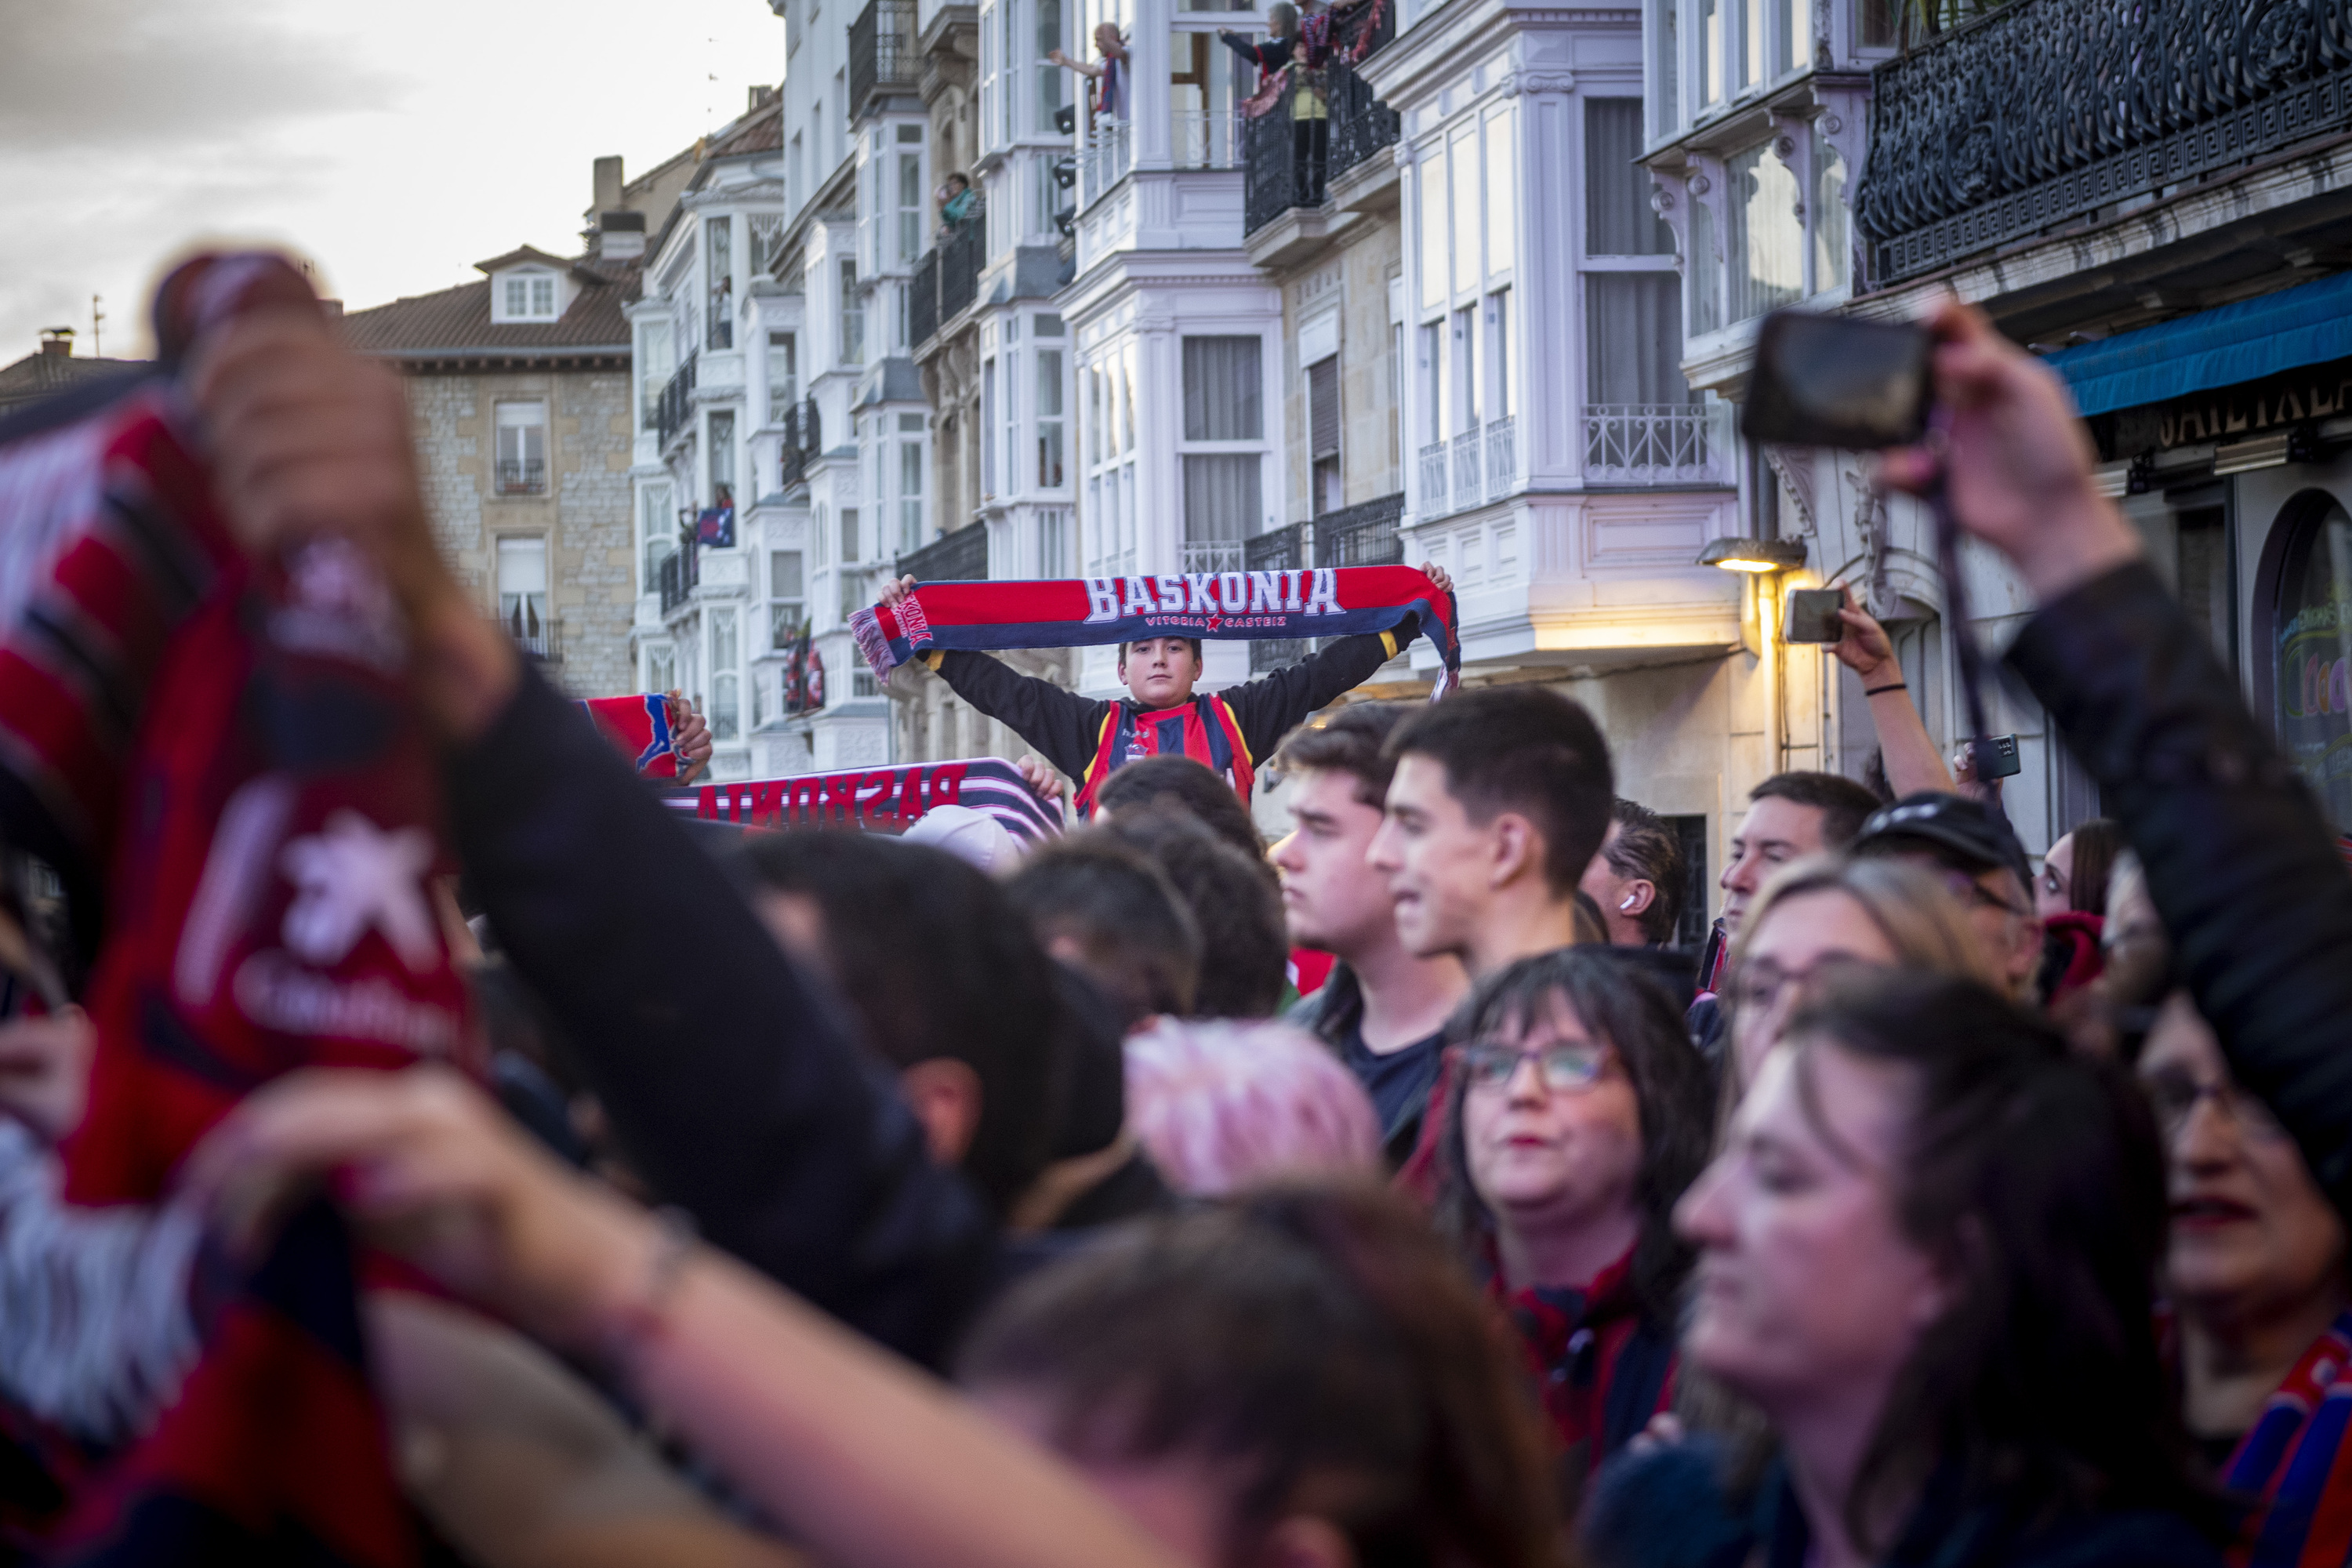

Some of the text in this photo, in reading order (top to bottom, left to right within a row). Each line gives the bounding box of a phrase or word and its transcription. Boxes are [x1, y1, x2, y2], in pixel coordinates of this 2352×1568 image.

[1083, 568, 1346, 624] BASKONIA
[1145, 615, 1287, 627] VITORIA GASTEIZ
